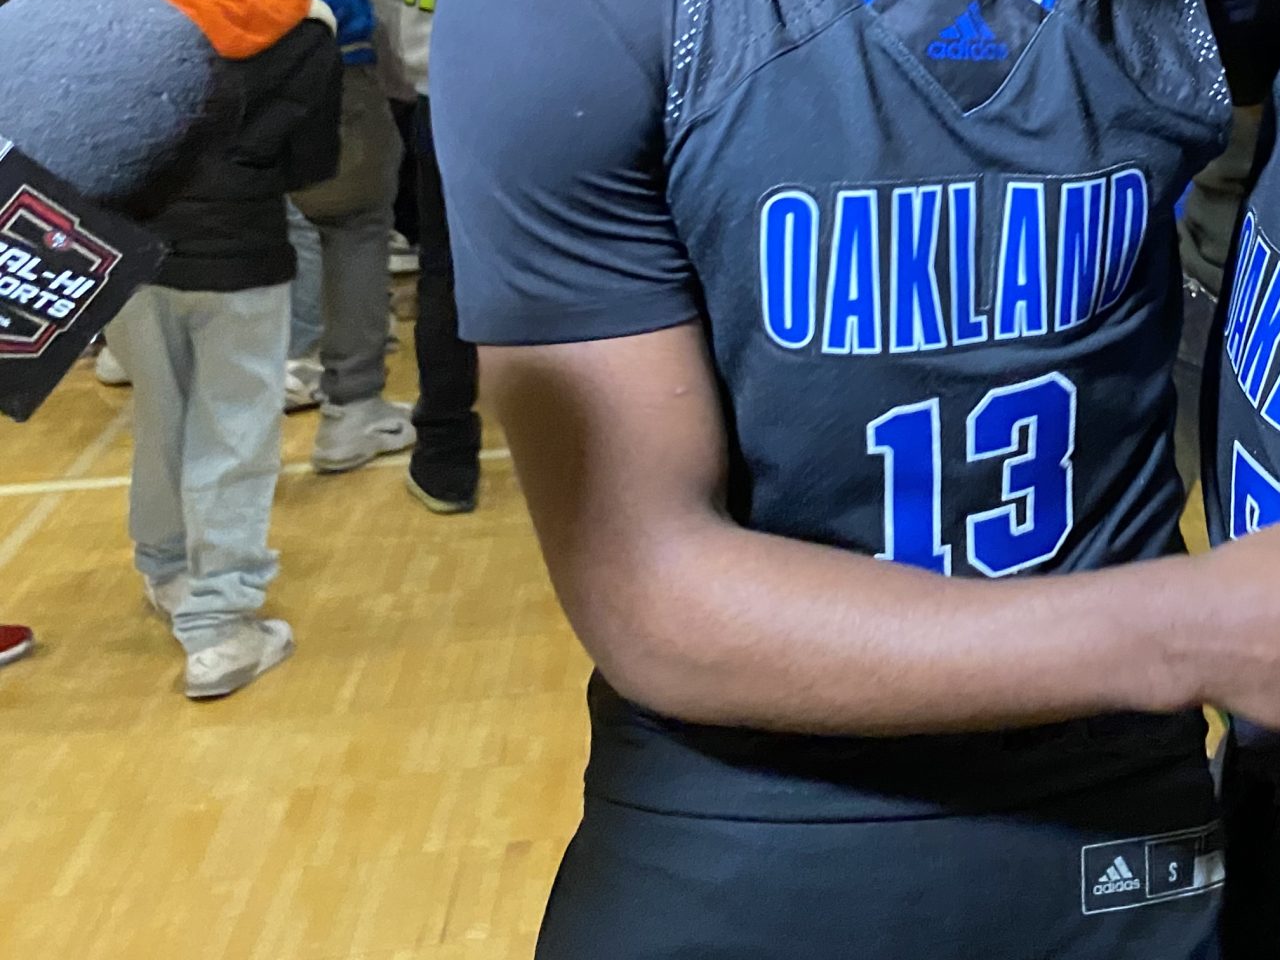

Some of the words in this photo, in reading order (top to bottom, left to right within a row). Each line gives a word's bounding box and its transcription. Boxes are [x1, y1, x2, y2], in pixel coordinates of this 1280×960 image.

[0, 240, 96, 299] AL-HI
[760, 168, 1149, 354] OAKLAND
[0, 273, 76, 318] ORTS
[866, 370, 1078, 578] 13
[1093, 878, 1141, 896] adidas
[1168, 861, 1178, 882] S
